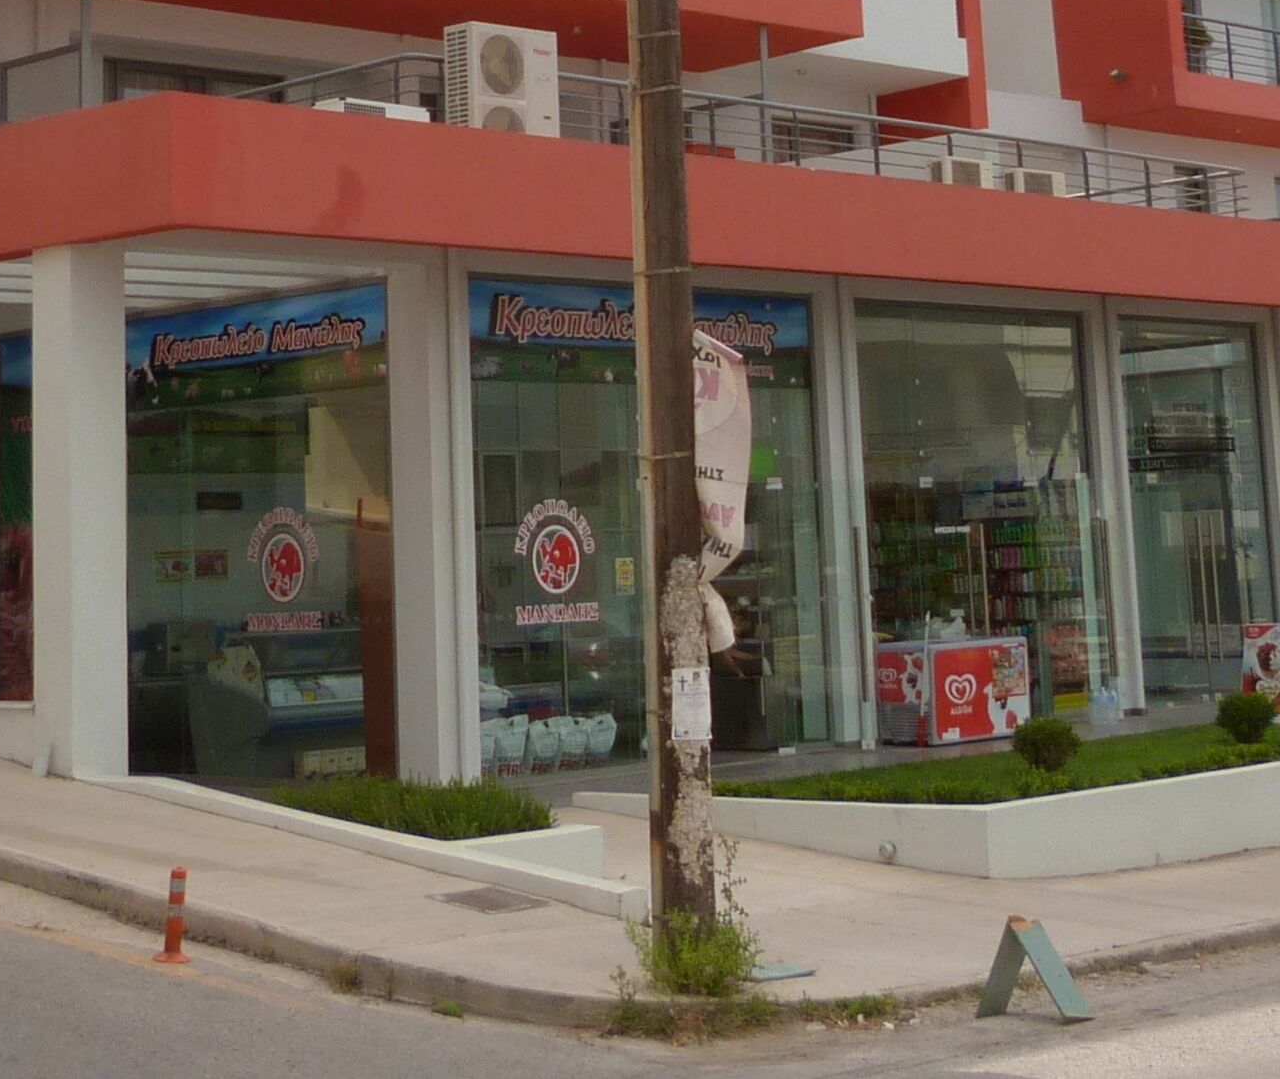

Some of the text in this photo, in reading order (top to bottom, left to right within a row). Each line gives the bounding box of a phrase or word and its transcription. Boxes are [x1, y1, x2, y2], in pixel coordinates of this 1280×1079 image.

[153, 315, 364, 369] Κρεοπωλείο Μανώλης
[494, 295, 775, 356] Κρεοπωλε ανώλης
[695, 466, 724, 481] ΣΤΗ
[247, 507, 320, 562] ΚΡΕΟΠΩΛΕΙΟ
[515, 499, 596, 555] ΚΡΕΟΠΩΛΕΙΟ
[247, 611, 323, 632] ΜΑΝΩΛΗΣ
[516, 602, 600, 625] ΜΑΝΩΛΗΣ
